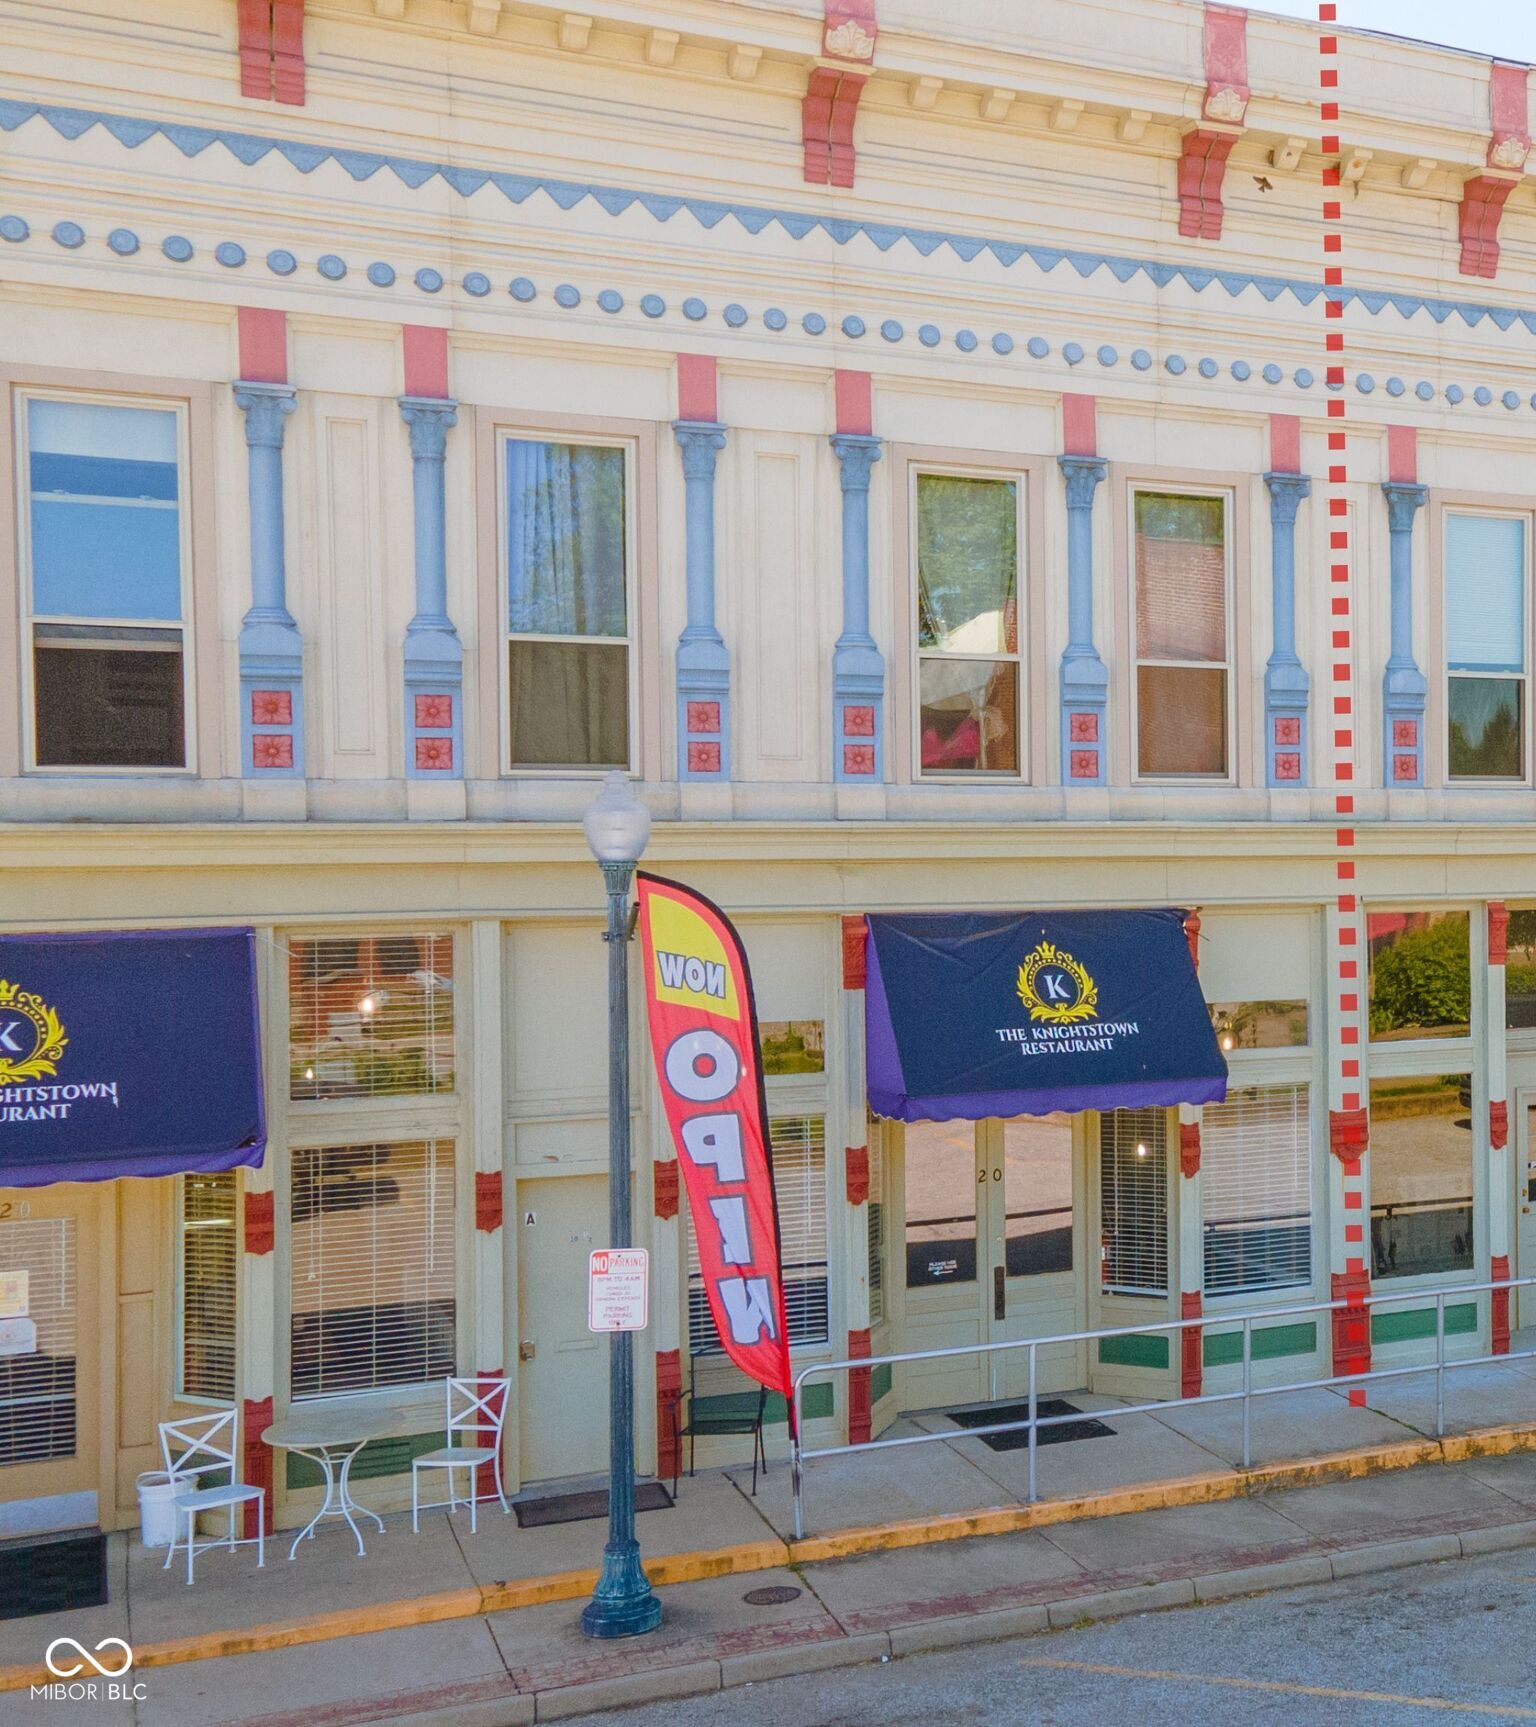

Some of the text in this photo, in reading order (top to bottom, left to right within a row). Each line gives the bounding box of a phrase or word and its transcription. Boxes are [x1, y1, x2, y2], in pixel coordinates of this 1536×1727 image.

[1043, 974, 1071, 999] K
[995, 1022, 1140, 1042] THE KNIGHTSTOWN
[1021, 1038, 1114, 1056] RESTAURANT
[0, 1081, 118, 1103] HTSTOWN
[526, 1213, 536, 1225] A
[592, 1256, 644, 1272] NO PARKING
